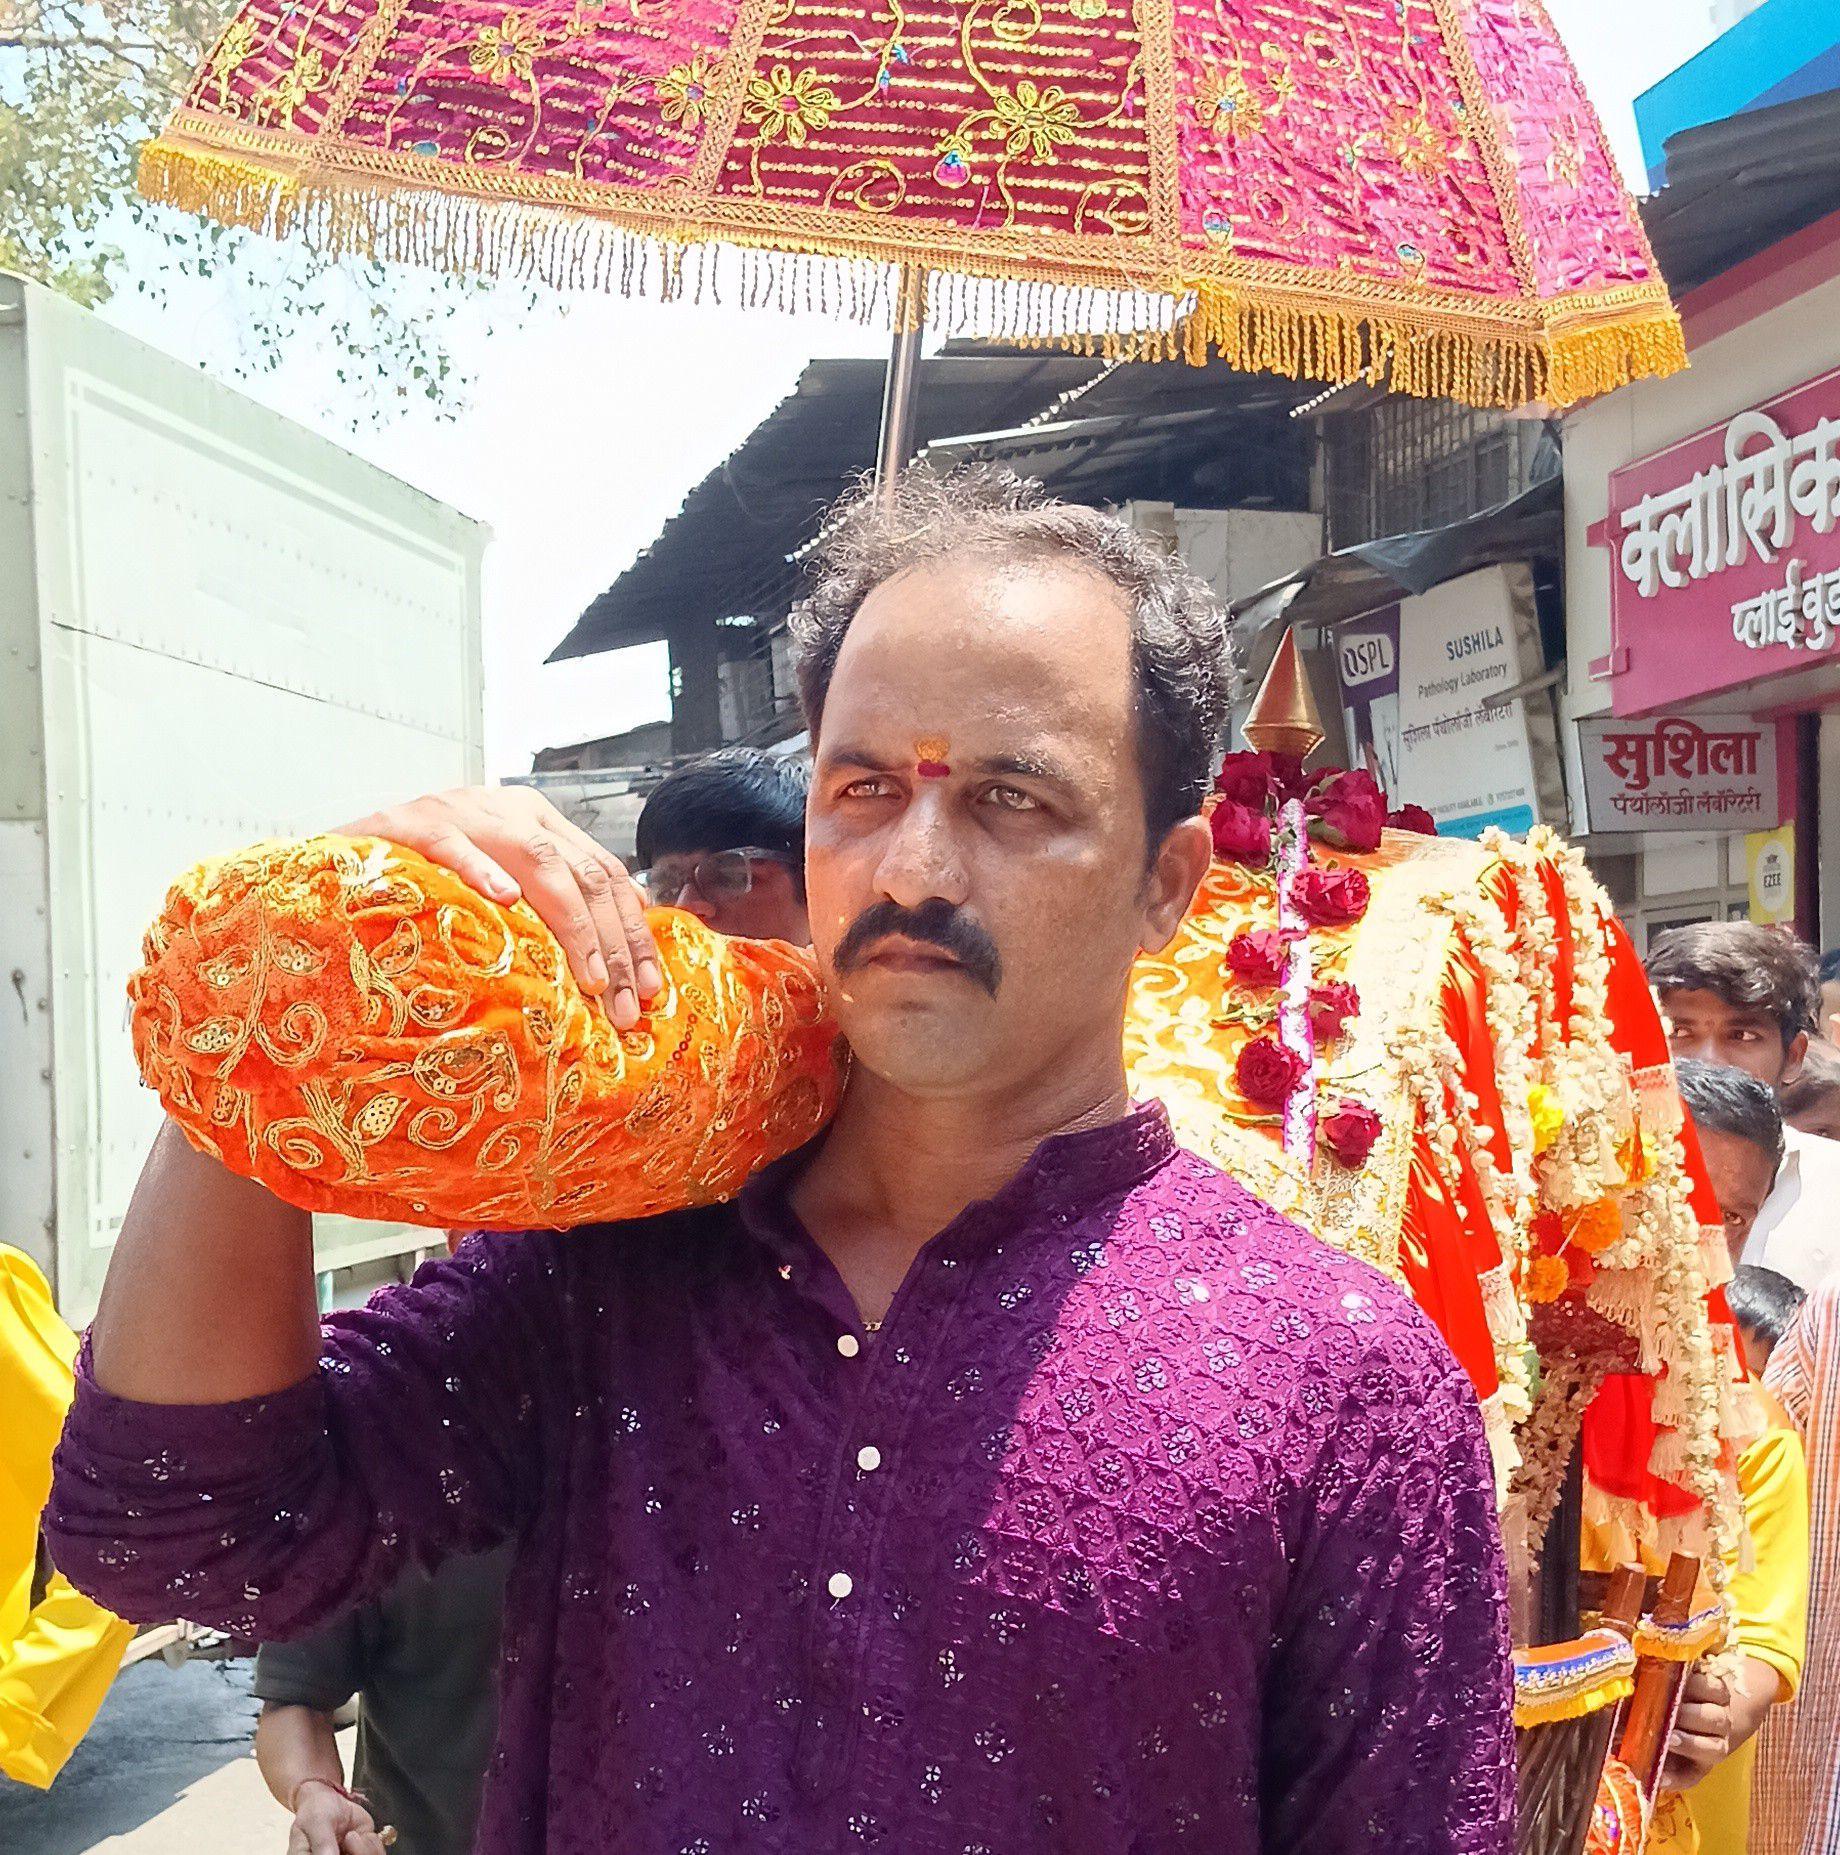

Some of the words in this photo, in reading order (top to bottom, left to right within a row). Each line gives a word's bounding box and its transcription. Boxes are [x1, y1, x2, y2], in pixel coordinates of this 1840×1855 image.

[1446, 626, 1504, 660] SUSHILA
[1418, 676, 1459, 698] Pathology
[1460, 663, 1508, 687] Laboratory
[1602, 718, 1762, 790] सुशिला
